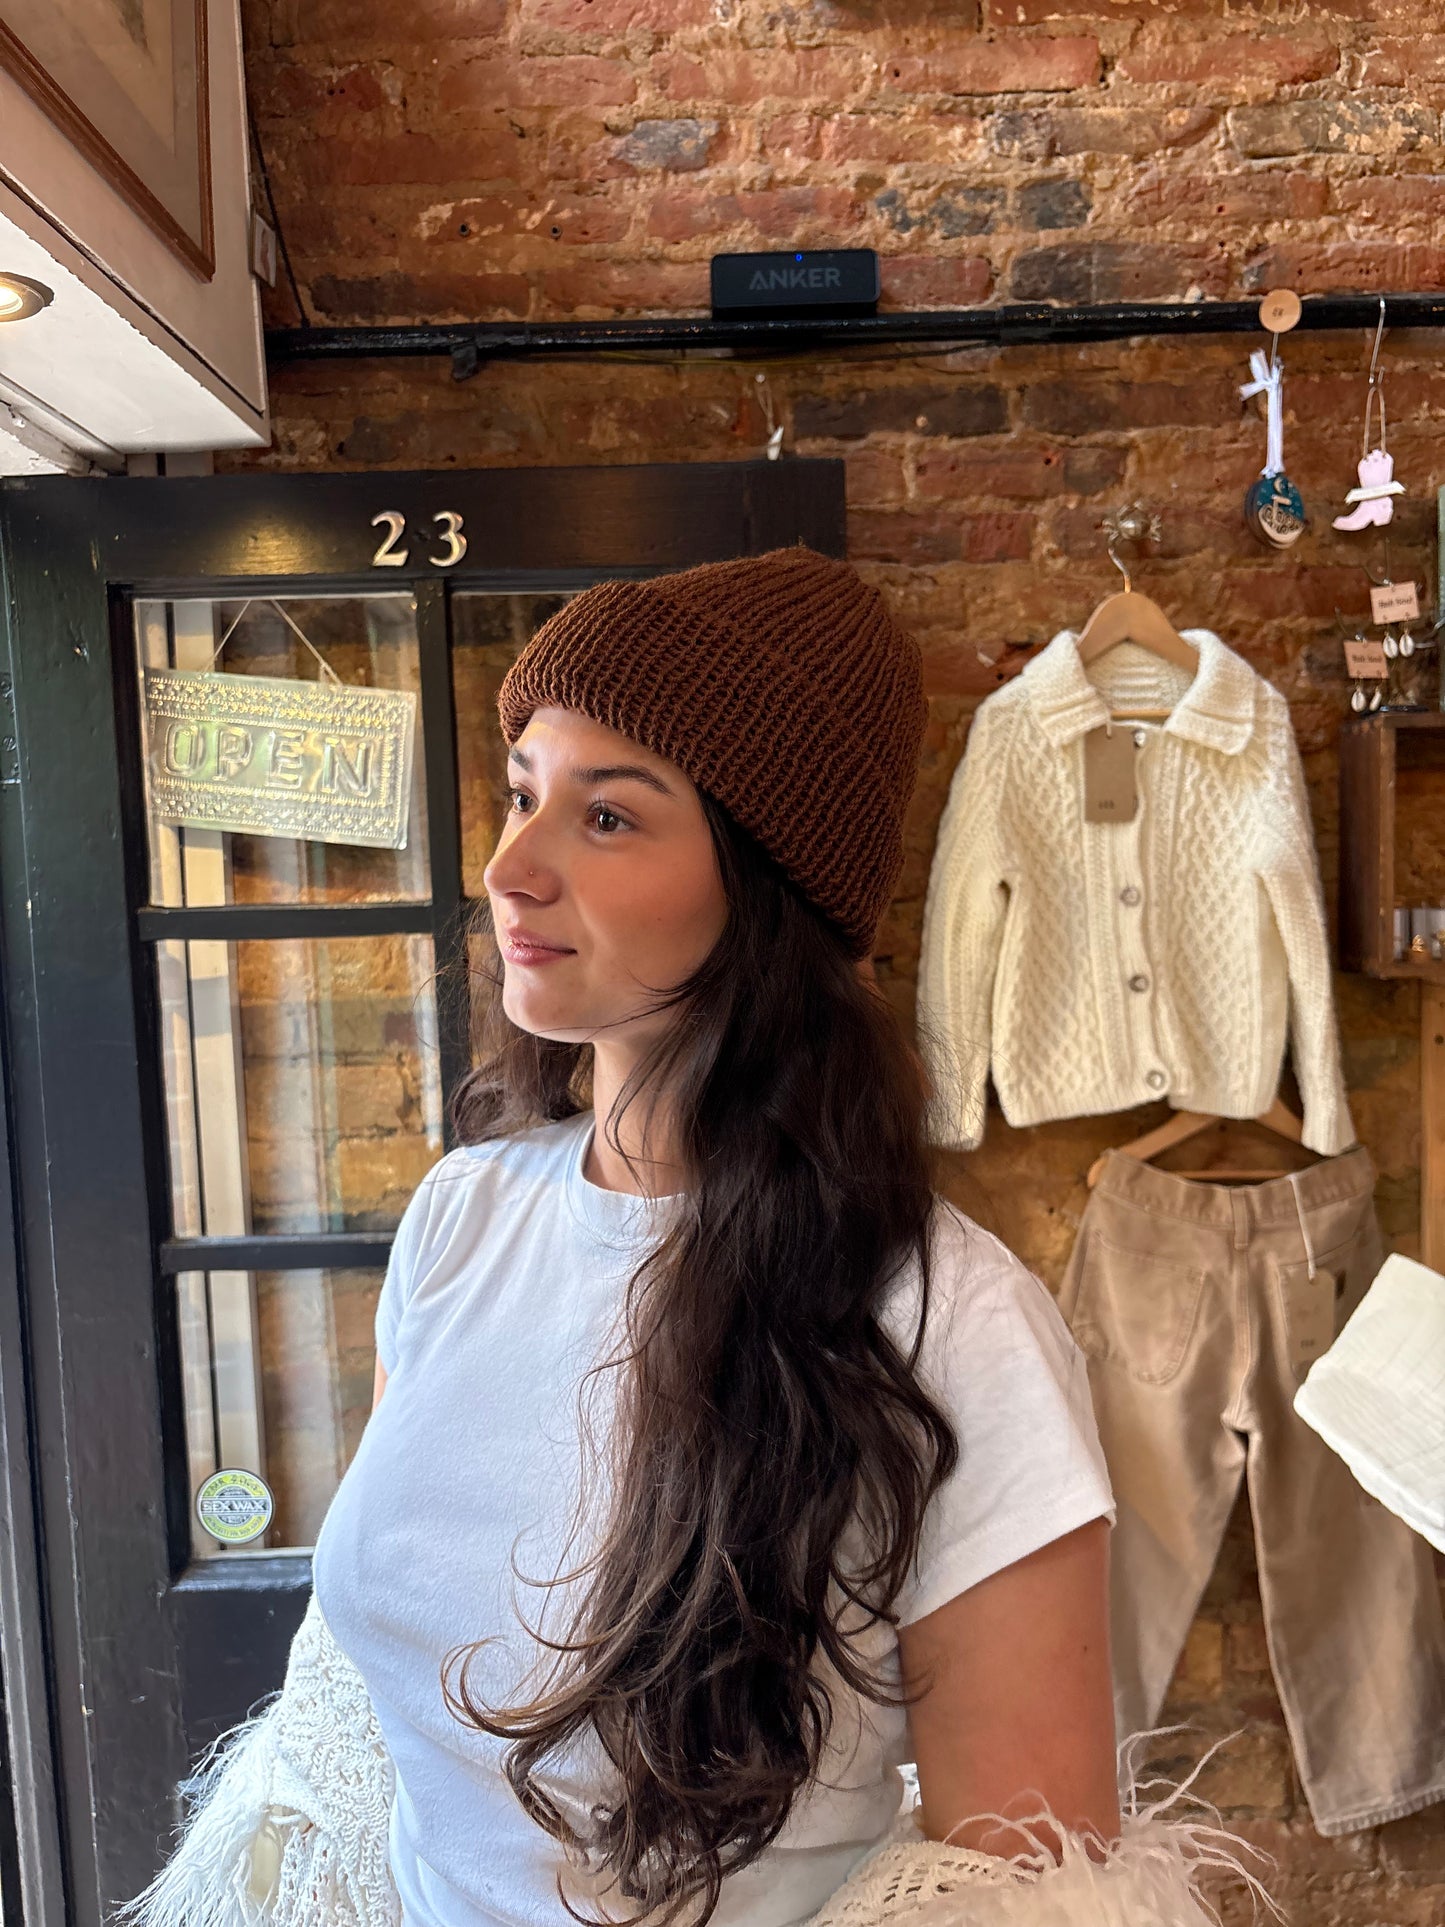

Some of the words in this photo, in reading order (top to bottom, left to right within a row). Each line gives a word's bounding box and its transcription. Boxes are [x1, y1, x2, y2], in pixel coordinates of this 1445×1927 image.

[749, 267, 841, 290] ANKER
[371, 510, 467, 567] 23
[164, 722, 375, 798] OPEN
